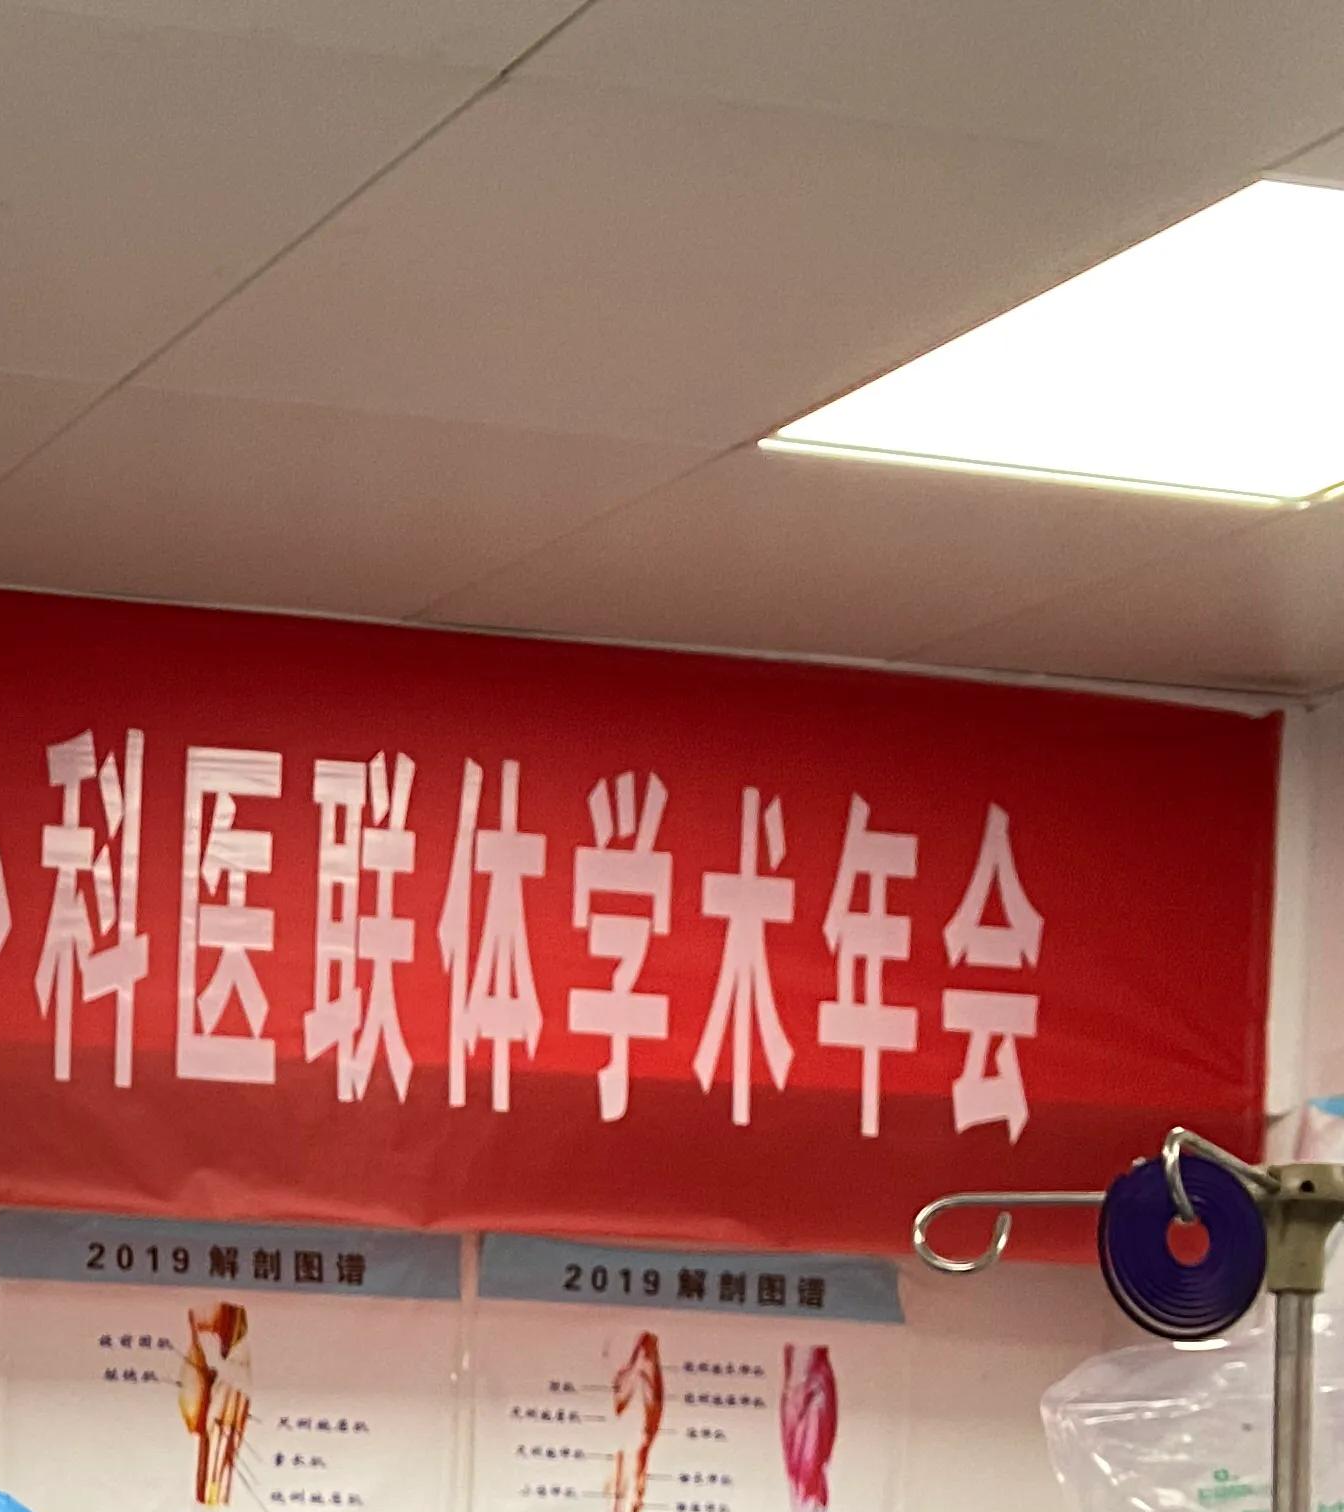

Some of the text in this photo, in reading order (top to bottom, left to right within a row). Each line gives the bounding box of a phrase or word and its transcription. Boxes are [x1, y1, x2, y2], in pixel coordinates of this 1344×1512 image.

[86, 1242, 366, 1286] 2019 解剖图谱
[563, 1263, 826, 1309] 2019 解剖图谱
